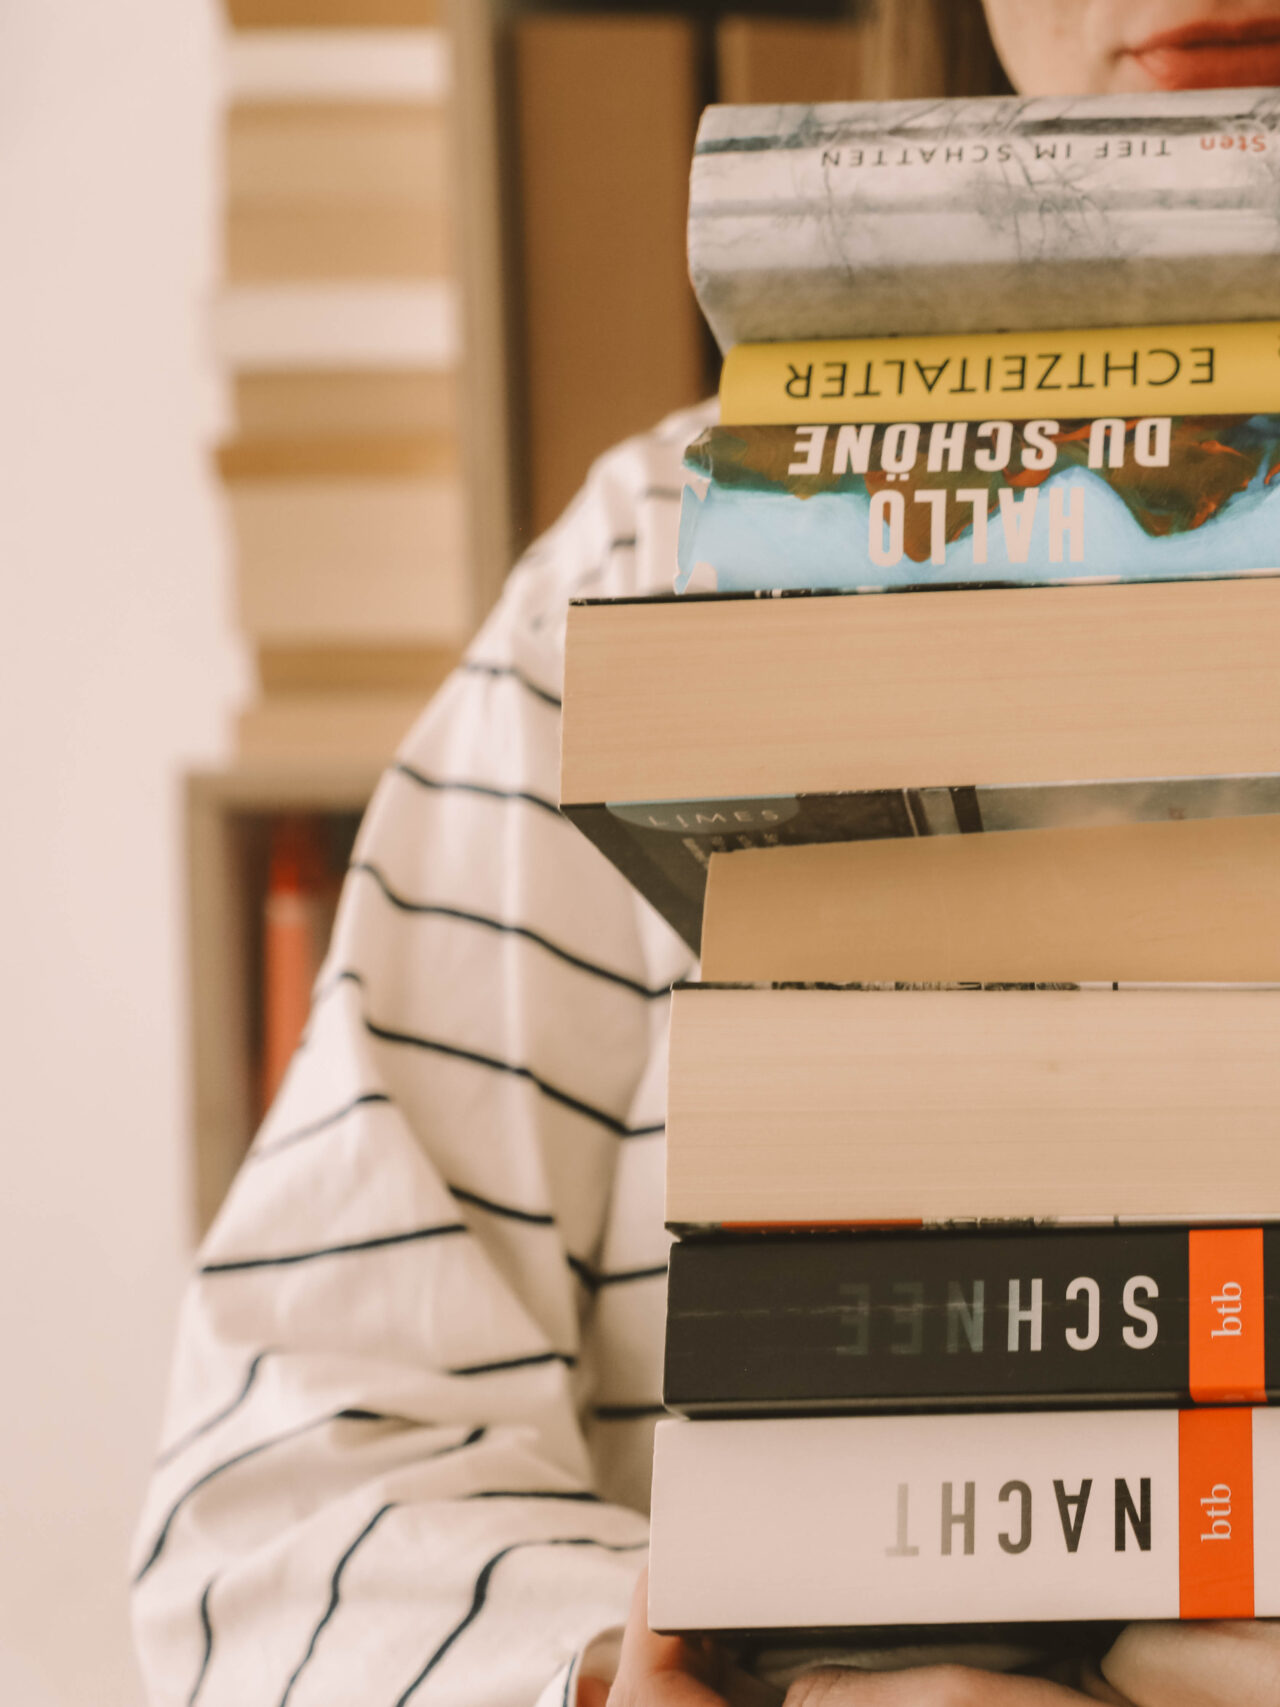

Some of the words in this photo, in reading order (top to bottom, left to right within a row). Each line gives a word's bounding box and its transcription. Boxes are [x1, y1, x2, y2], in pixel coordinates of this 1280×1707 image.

[822, 144, 1012, 166] SCHATTEN
[1036, 143, 1071, 159] IM
[1095, 139, 1171, 159] TIEF
[1201, 134, 1266, 151] Sten
[785, 347, 1215, 399] ECHTZEITALTER
[788, 420, 1060, 481] SCHÖNE
[1088, 418, 1172, 469] DU
[868, 487, 1085, 567] HALLO
[648, 810, 779, 828] LIMES
[835, 1275, 1159, 1356] SCHNEE
[1211, 1281, 1242, 1339] btb
[885, 1477, 1151, 1557] NACHT
[1200, 1483, 1232, 1542] btb
